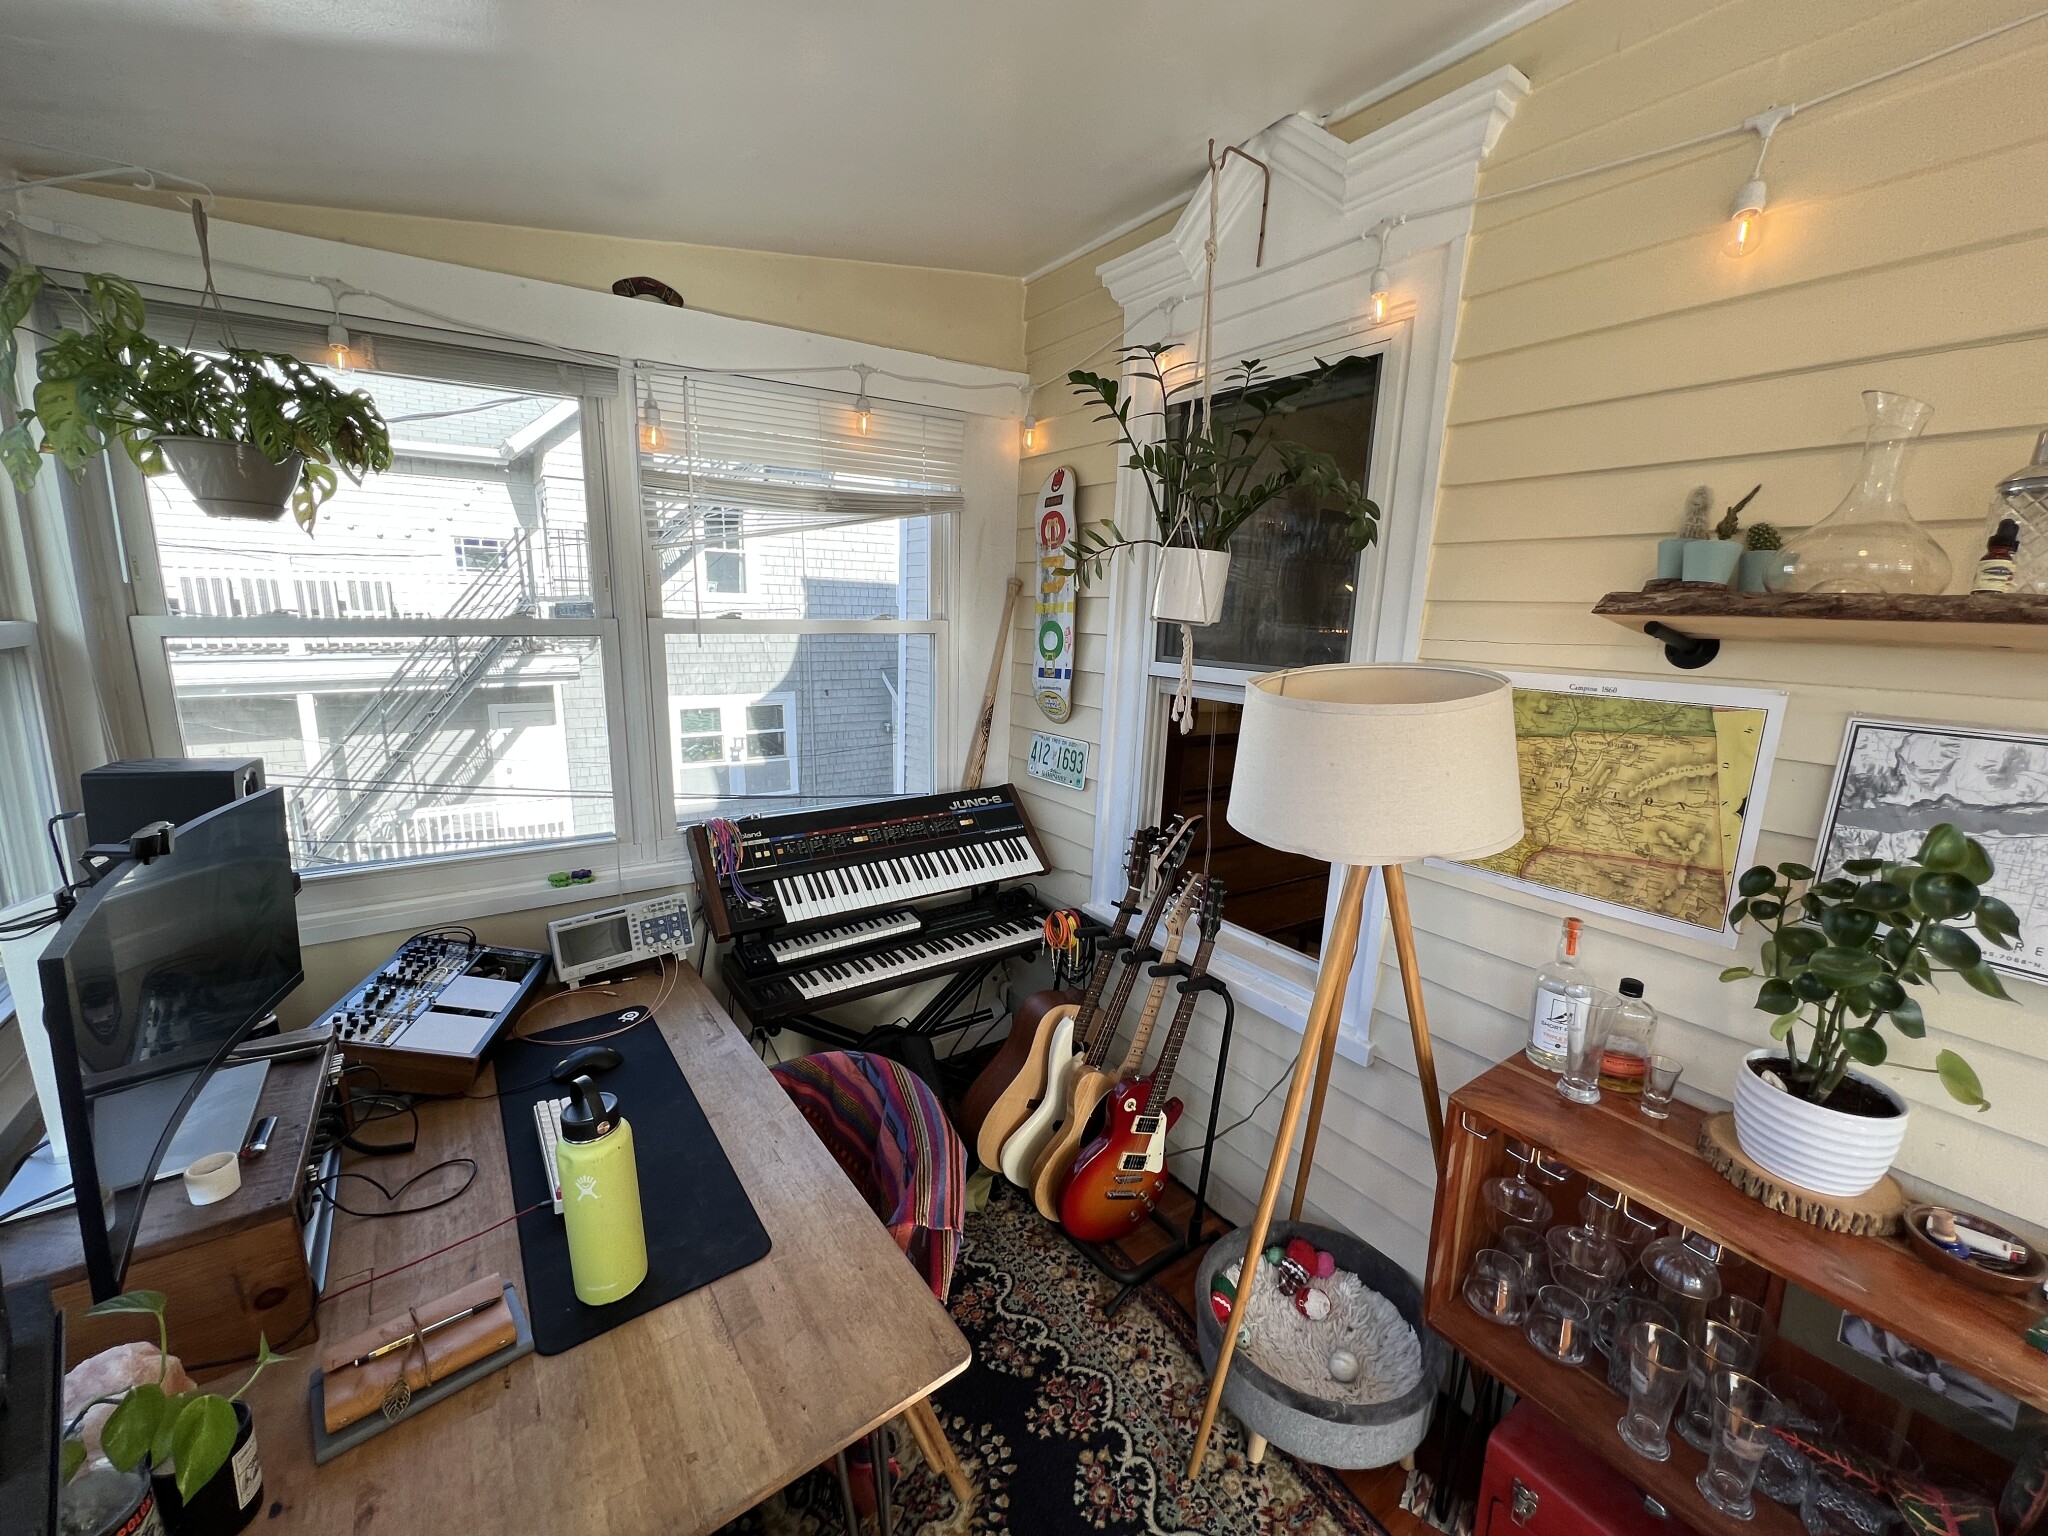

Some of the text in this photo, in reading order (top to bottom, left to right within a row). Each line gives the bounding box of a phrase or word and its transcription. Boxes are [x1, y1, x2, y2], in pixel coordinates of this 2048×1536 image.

[1568, 684, 1618, 694] Campton 1860
[1030, 740, 1085, 774] 412 1693
[949, 795, 1002, 810] JUNO-6
[740, 830, 762, 840] oland
[1541, 1020, 1562, 1031] SHORT
